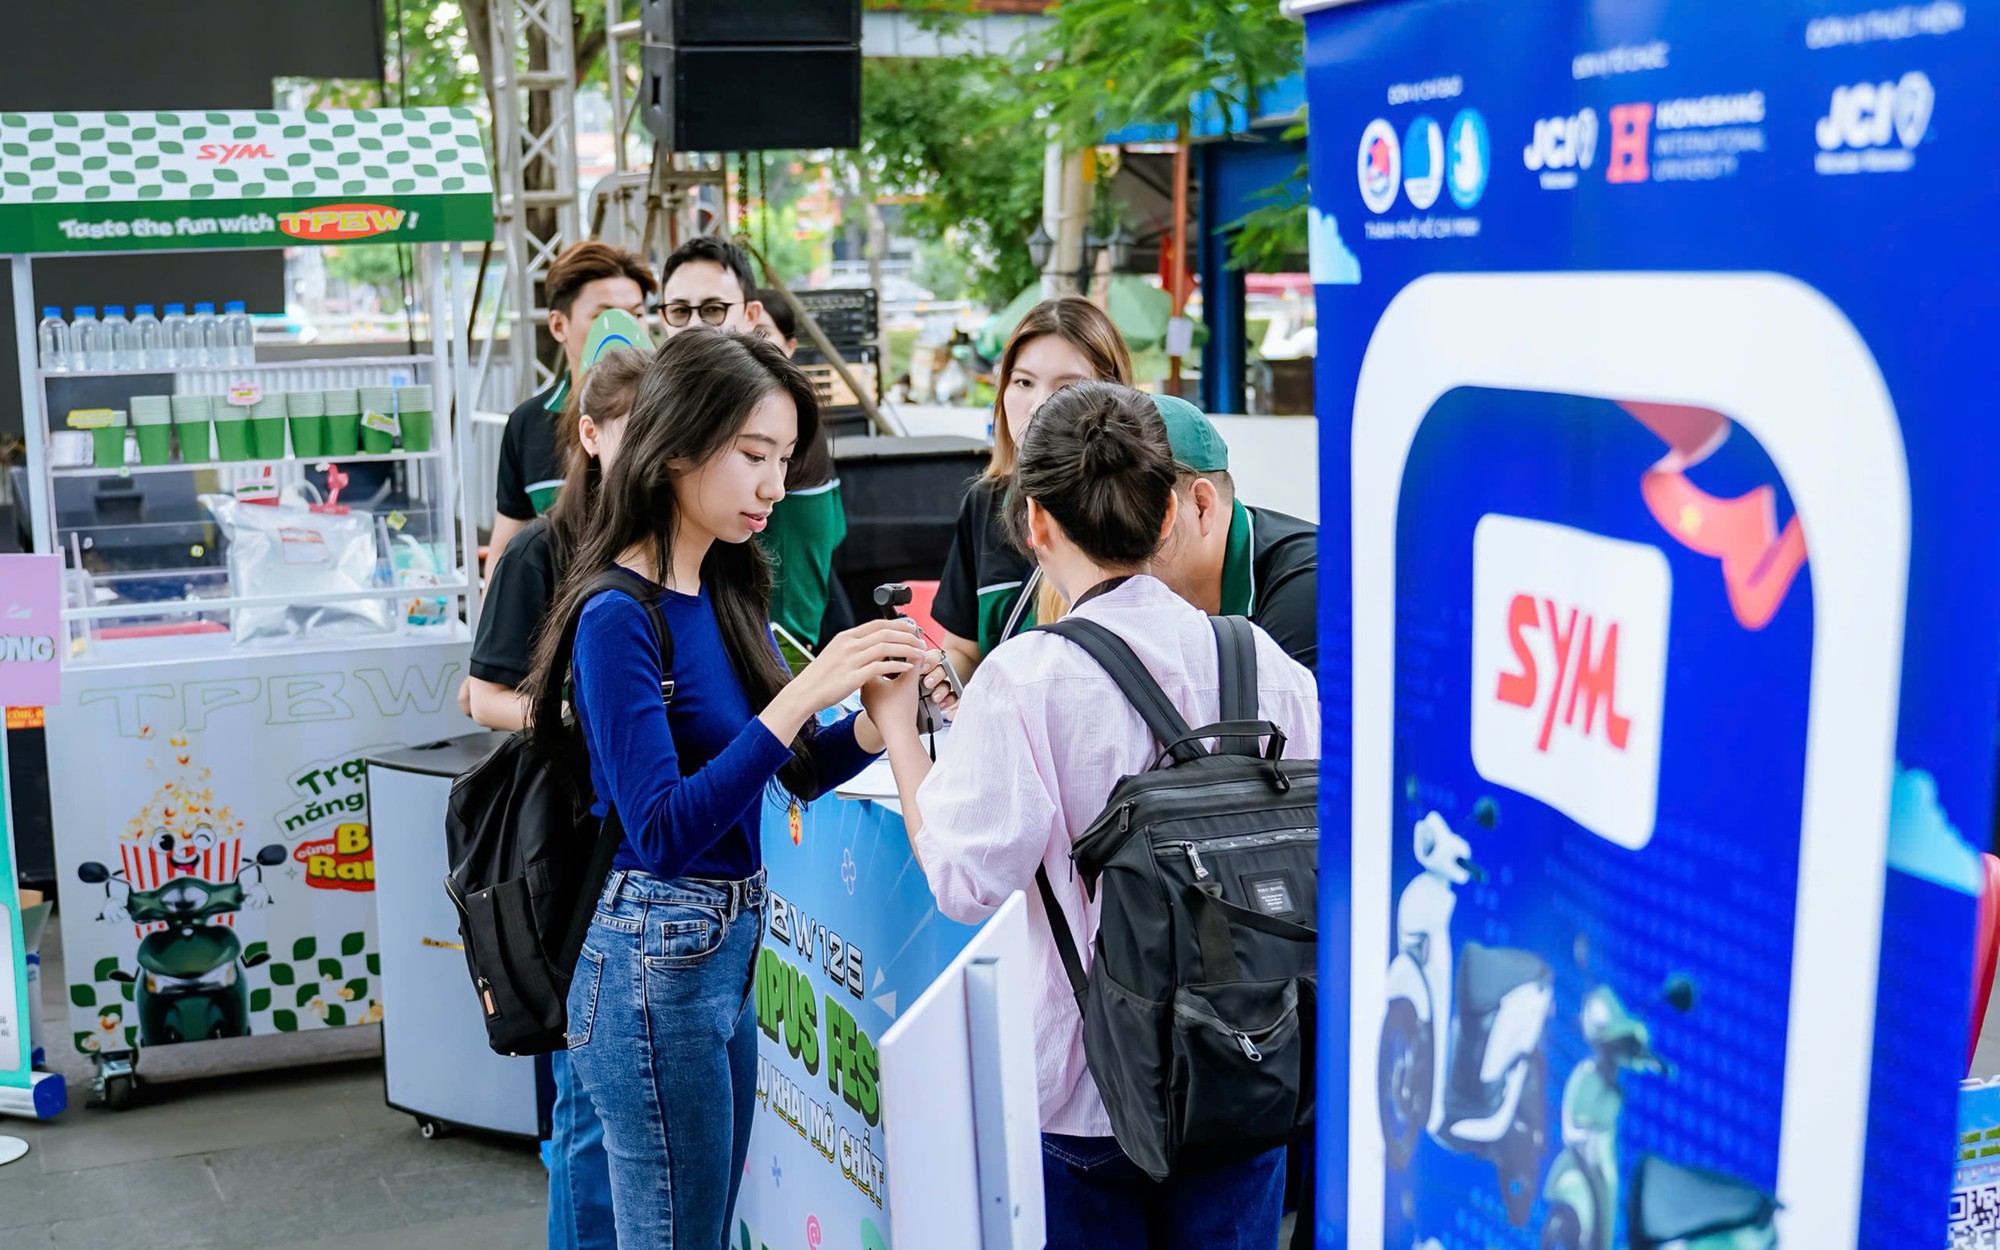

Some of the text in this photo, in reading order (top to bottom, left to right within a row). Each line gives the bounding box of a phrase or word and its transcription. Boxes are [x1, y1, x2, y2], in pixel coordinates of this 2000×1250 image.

[1523, 115, 1578, 171] JCI
[1815, 80, 1897, 151] JCI
[196, 143, 275, 165] SYM
[58, 218, 131, 239] Taste
[131, 217, 174, 237] the
[175, 216, 218, 236] fun
[219, 213, 276, 234] with
[79, 663, 461, 738] TPBW
[1496, 593, 1632, 752] SYM
[284, 792, 365, 832] năng
[297, 843, 336, 859] cùng
[825, 993, 882, 1130] FES
[771, 1065, 808, 1141] KHAI
[809, 1097, 836, 1163] MỞ
[839, 1126, 884, 1210] CHẤT
